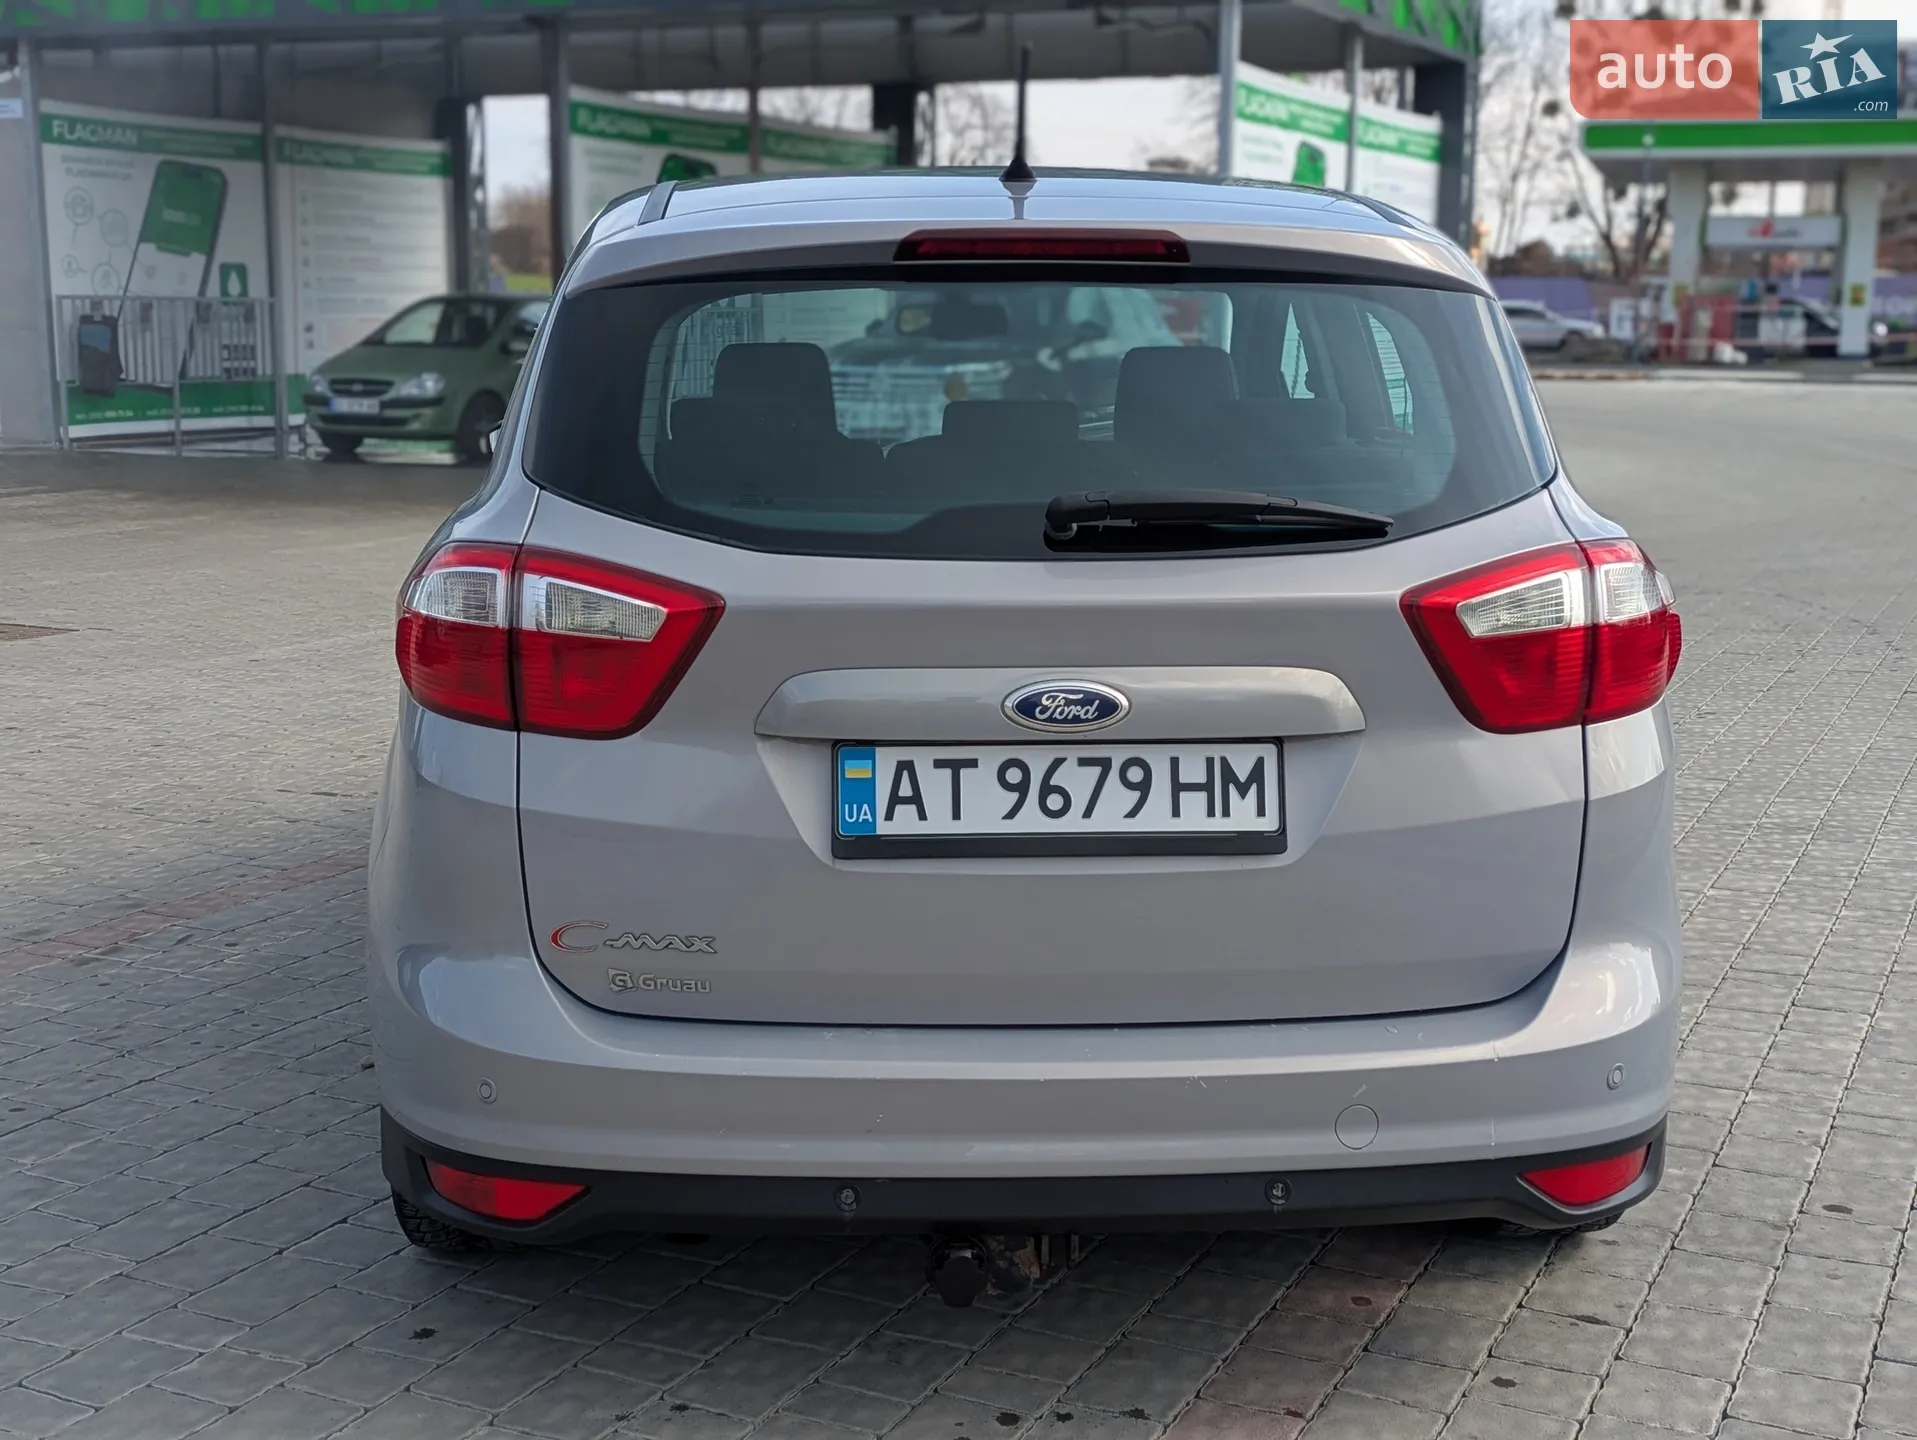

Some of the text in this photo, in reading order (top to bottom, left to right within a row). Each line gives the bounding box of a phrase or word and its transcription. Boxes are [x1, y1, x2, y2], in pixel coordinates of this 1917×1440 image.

[1034, 692, 1100, 722] Ford
[883, 755, 1267, 822] AT 9679 HM
[844, 803, 873, 823] UA
[638, 973, 712, 993] Gruau
